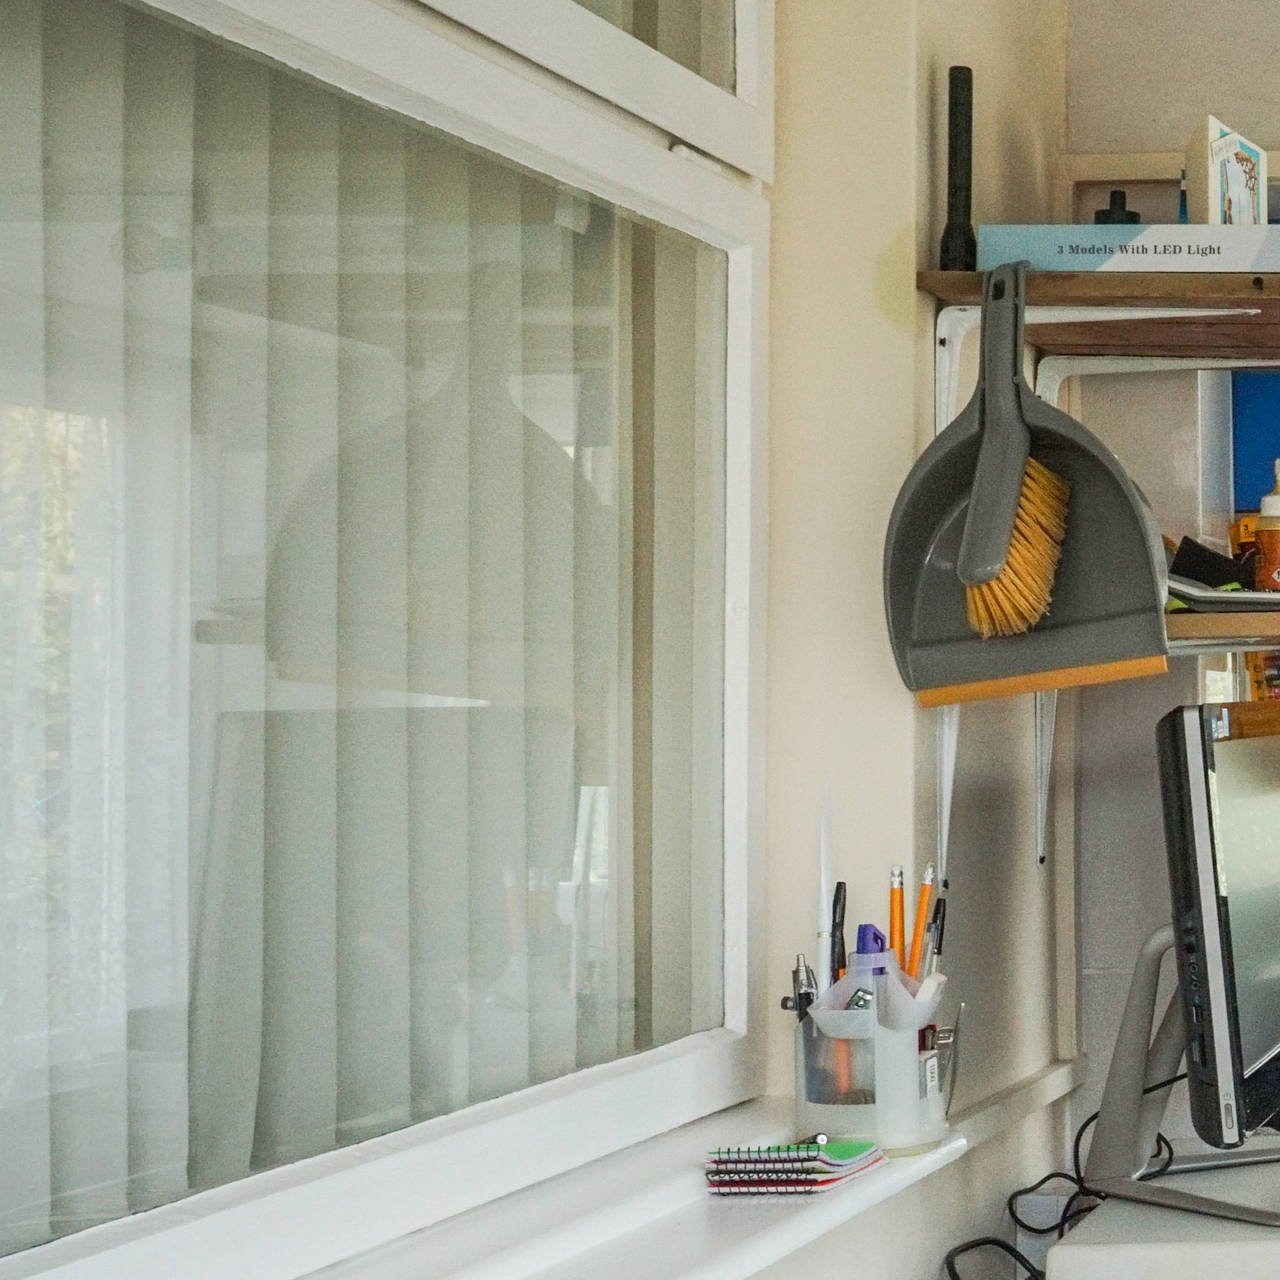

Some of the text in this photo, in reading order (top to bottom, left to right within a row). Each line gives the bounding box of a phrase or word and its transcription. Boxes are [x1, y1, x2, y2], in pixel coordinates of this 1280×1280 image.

[1057, 243, 1222, 257] 3 Models With LED Light
